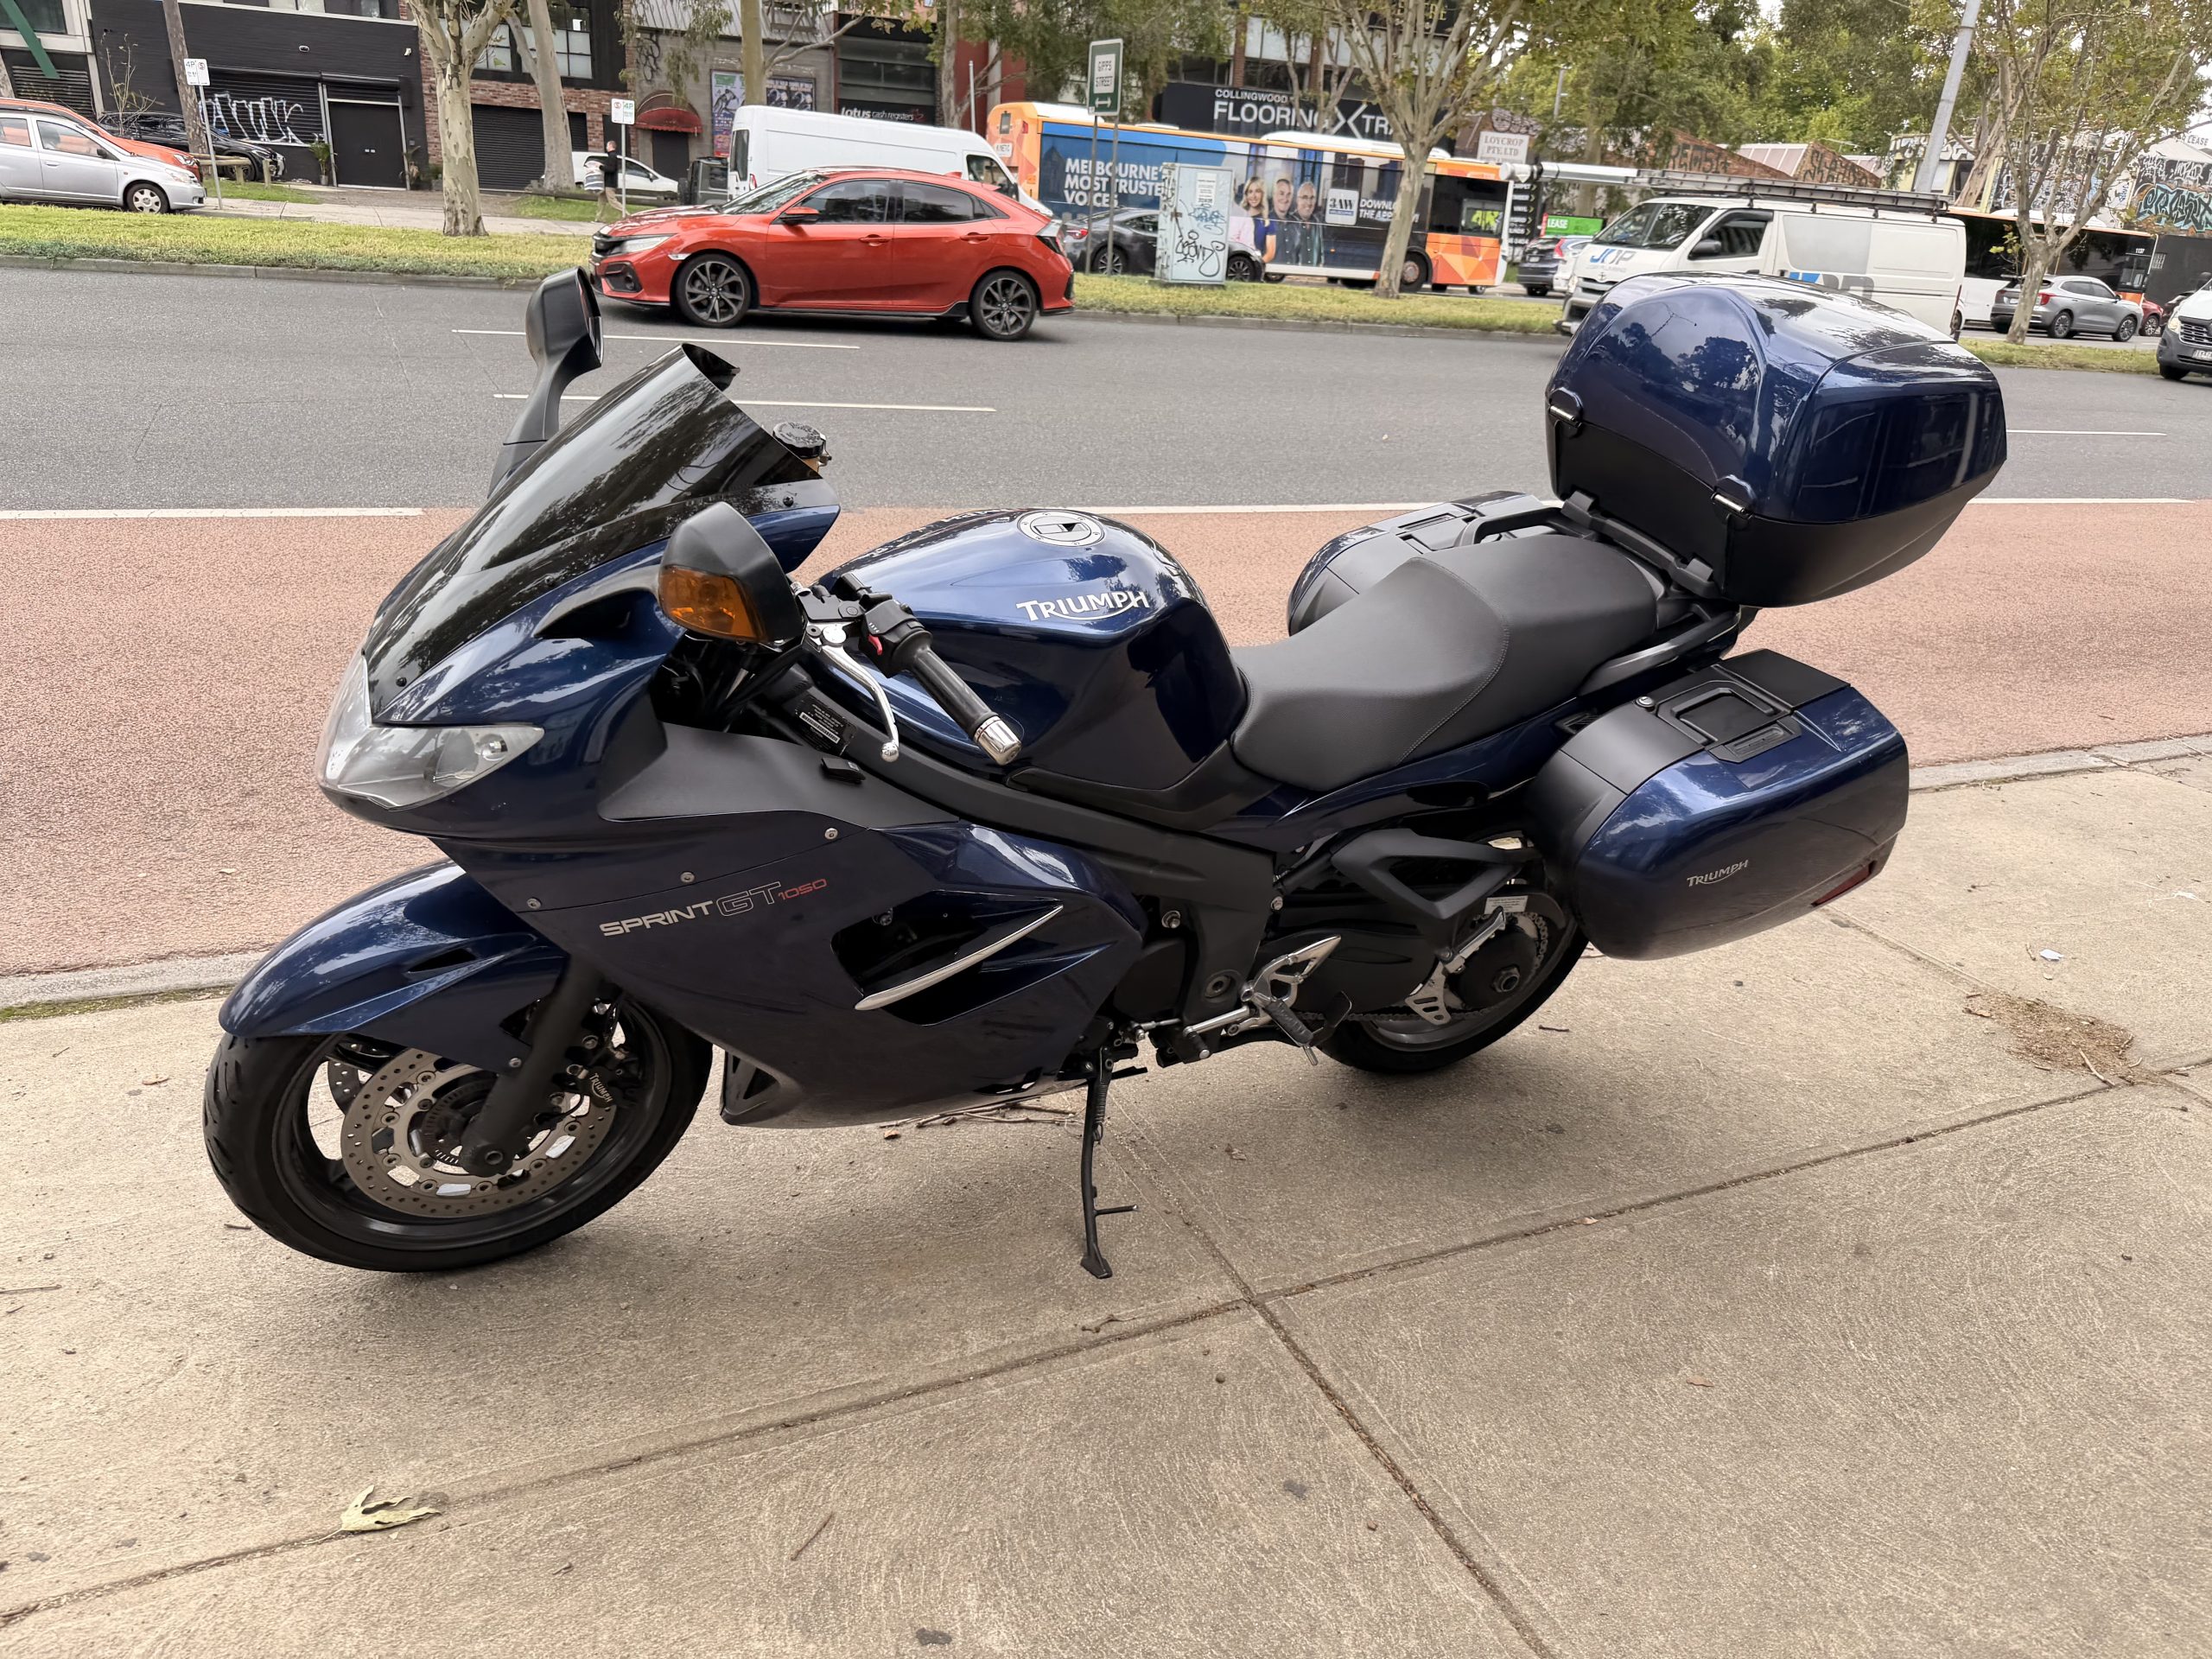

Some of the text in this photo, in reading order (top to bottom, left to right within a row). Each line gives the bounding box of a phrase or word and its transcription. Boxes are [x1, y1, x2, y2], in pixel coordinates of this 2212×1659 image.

[1215, 88, 1288, 104] COLLINGWOOD
[841, 106, 871, 119] lotus
[2187, 134, 2209, 146] LEASE
[1065, 157, 1163, 181] MELBOURNE'
[1064, 174, 1164, 197] MOST TRUSTE
[1359, 199, 1396, 211] DOWNL
[1359, 209, 1375, 219] THE
[1548, 218, 1568, 229] LEASE
[1016, 591, 1150, 621] TRIUMPH
[1687, 859, 1749, 887] TRIUMPH
[599, 878, 828, 937] SPRINT GT 1050
[589, 1072, 613, 1103] TRIUMPH
